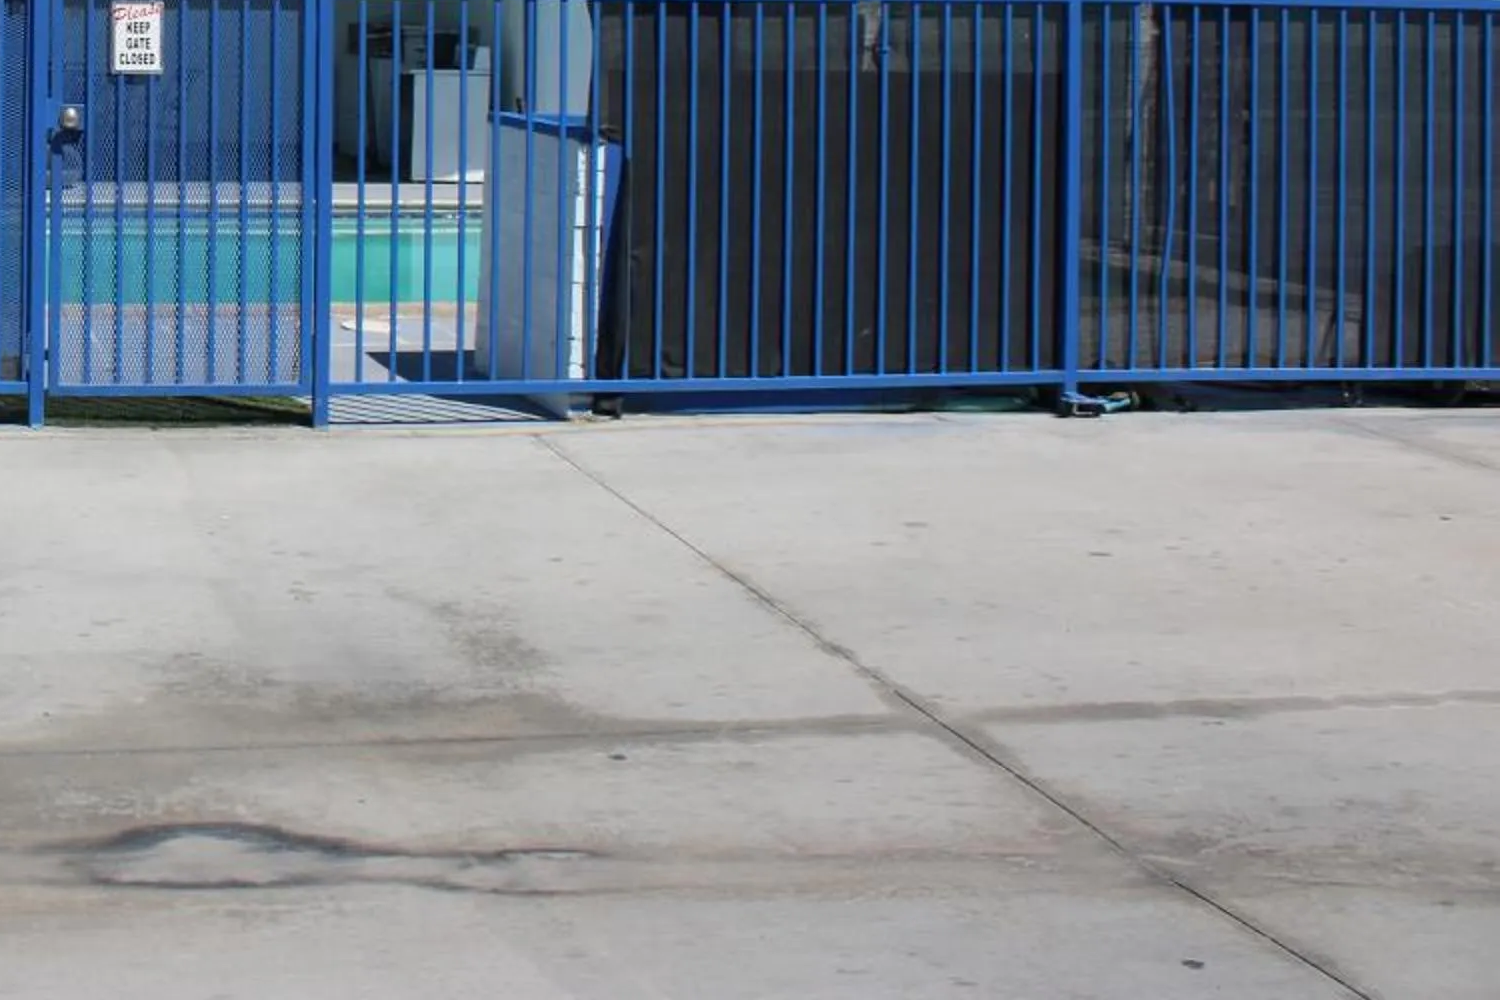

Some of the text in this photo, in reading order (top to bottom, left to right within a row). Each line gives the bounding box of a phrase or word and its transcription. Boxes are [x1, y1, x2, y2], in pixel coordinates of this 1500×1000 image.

[125, 21, 150, 34] KEEP
[125, 37, 152, 50] GATE
[119, 52, 157, 66] CLOSED
